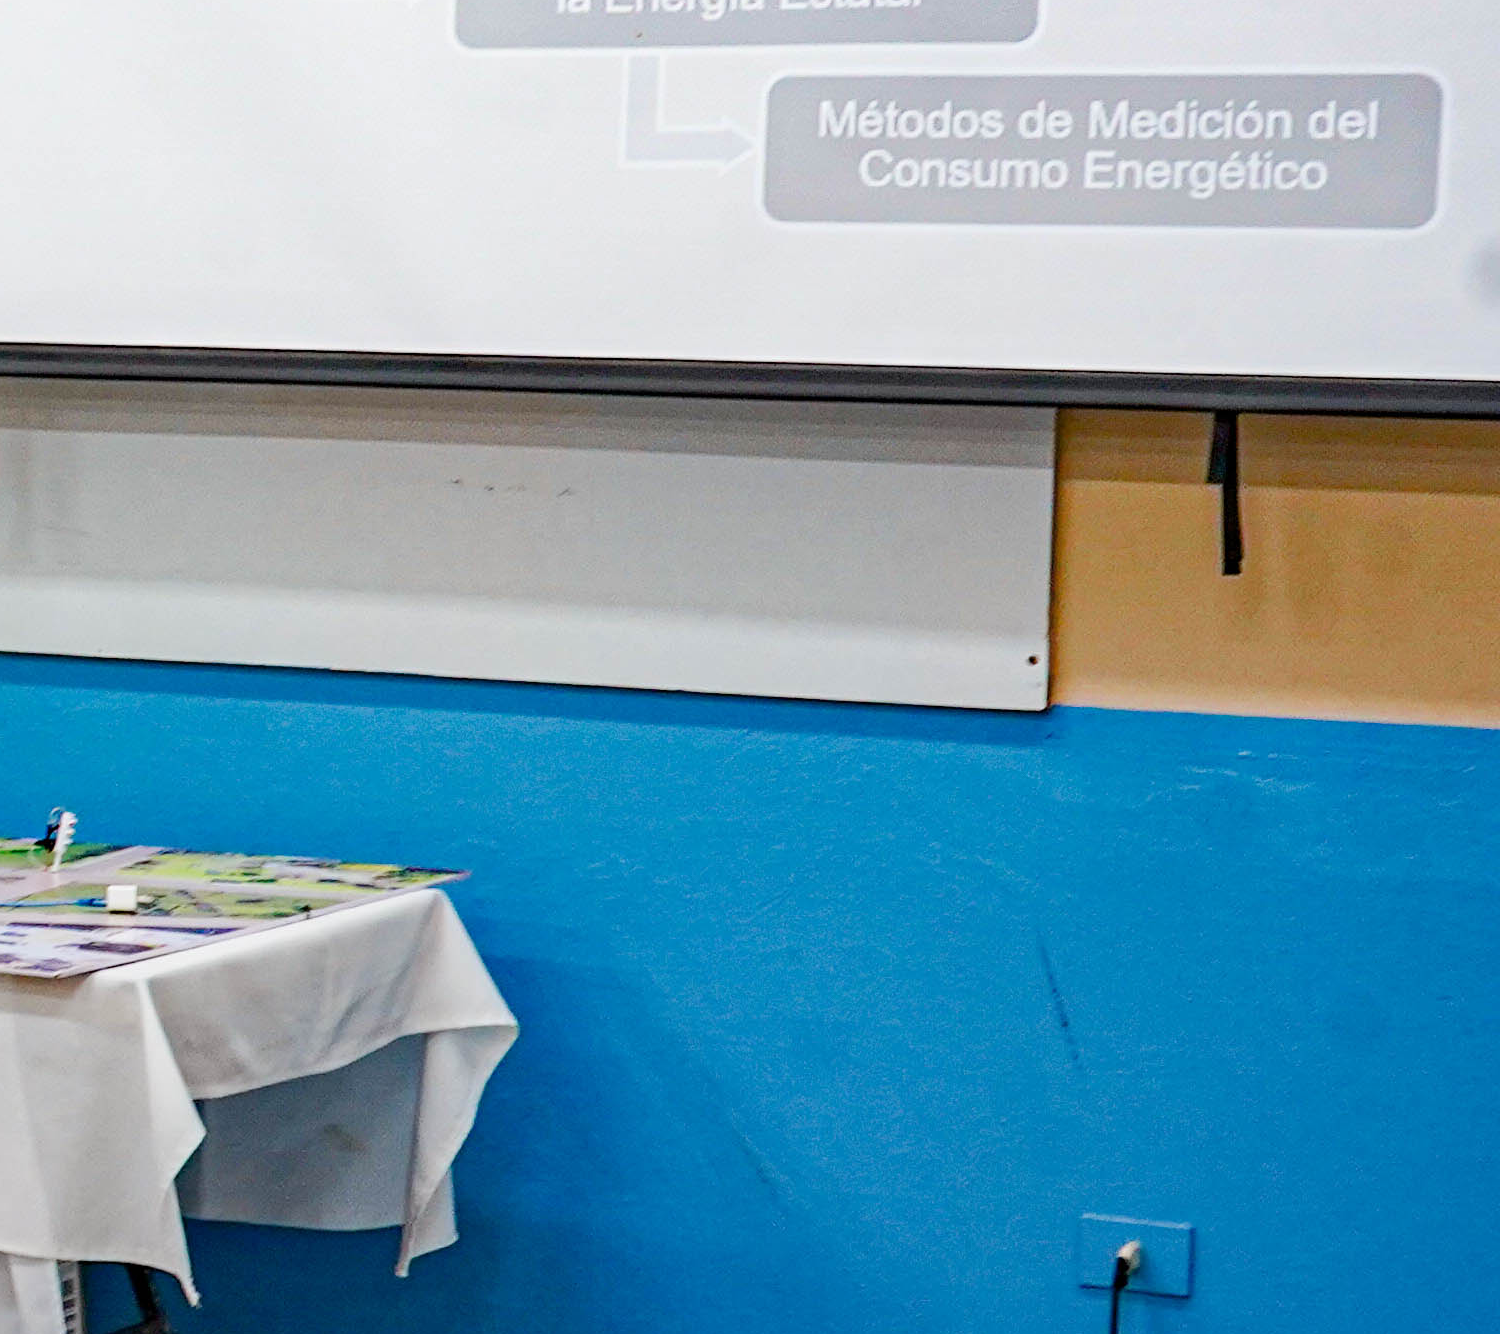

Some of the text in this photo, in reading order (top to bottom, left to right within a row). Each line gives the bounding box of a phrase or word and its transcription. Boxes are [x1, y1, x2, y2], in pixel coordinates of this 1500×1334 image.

[817, 98, 1378, 140] Métodos de Medición del
[858, 149, 1327, 199] Consumo Energético
